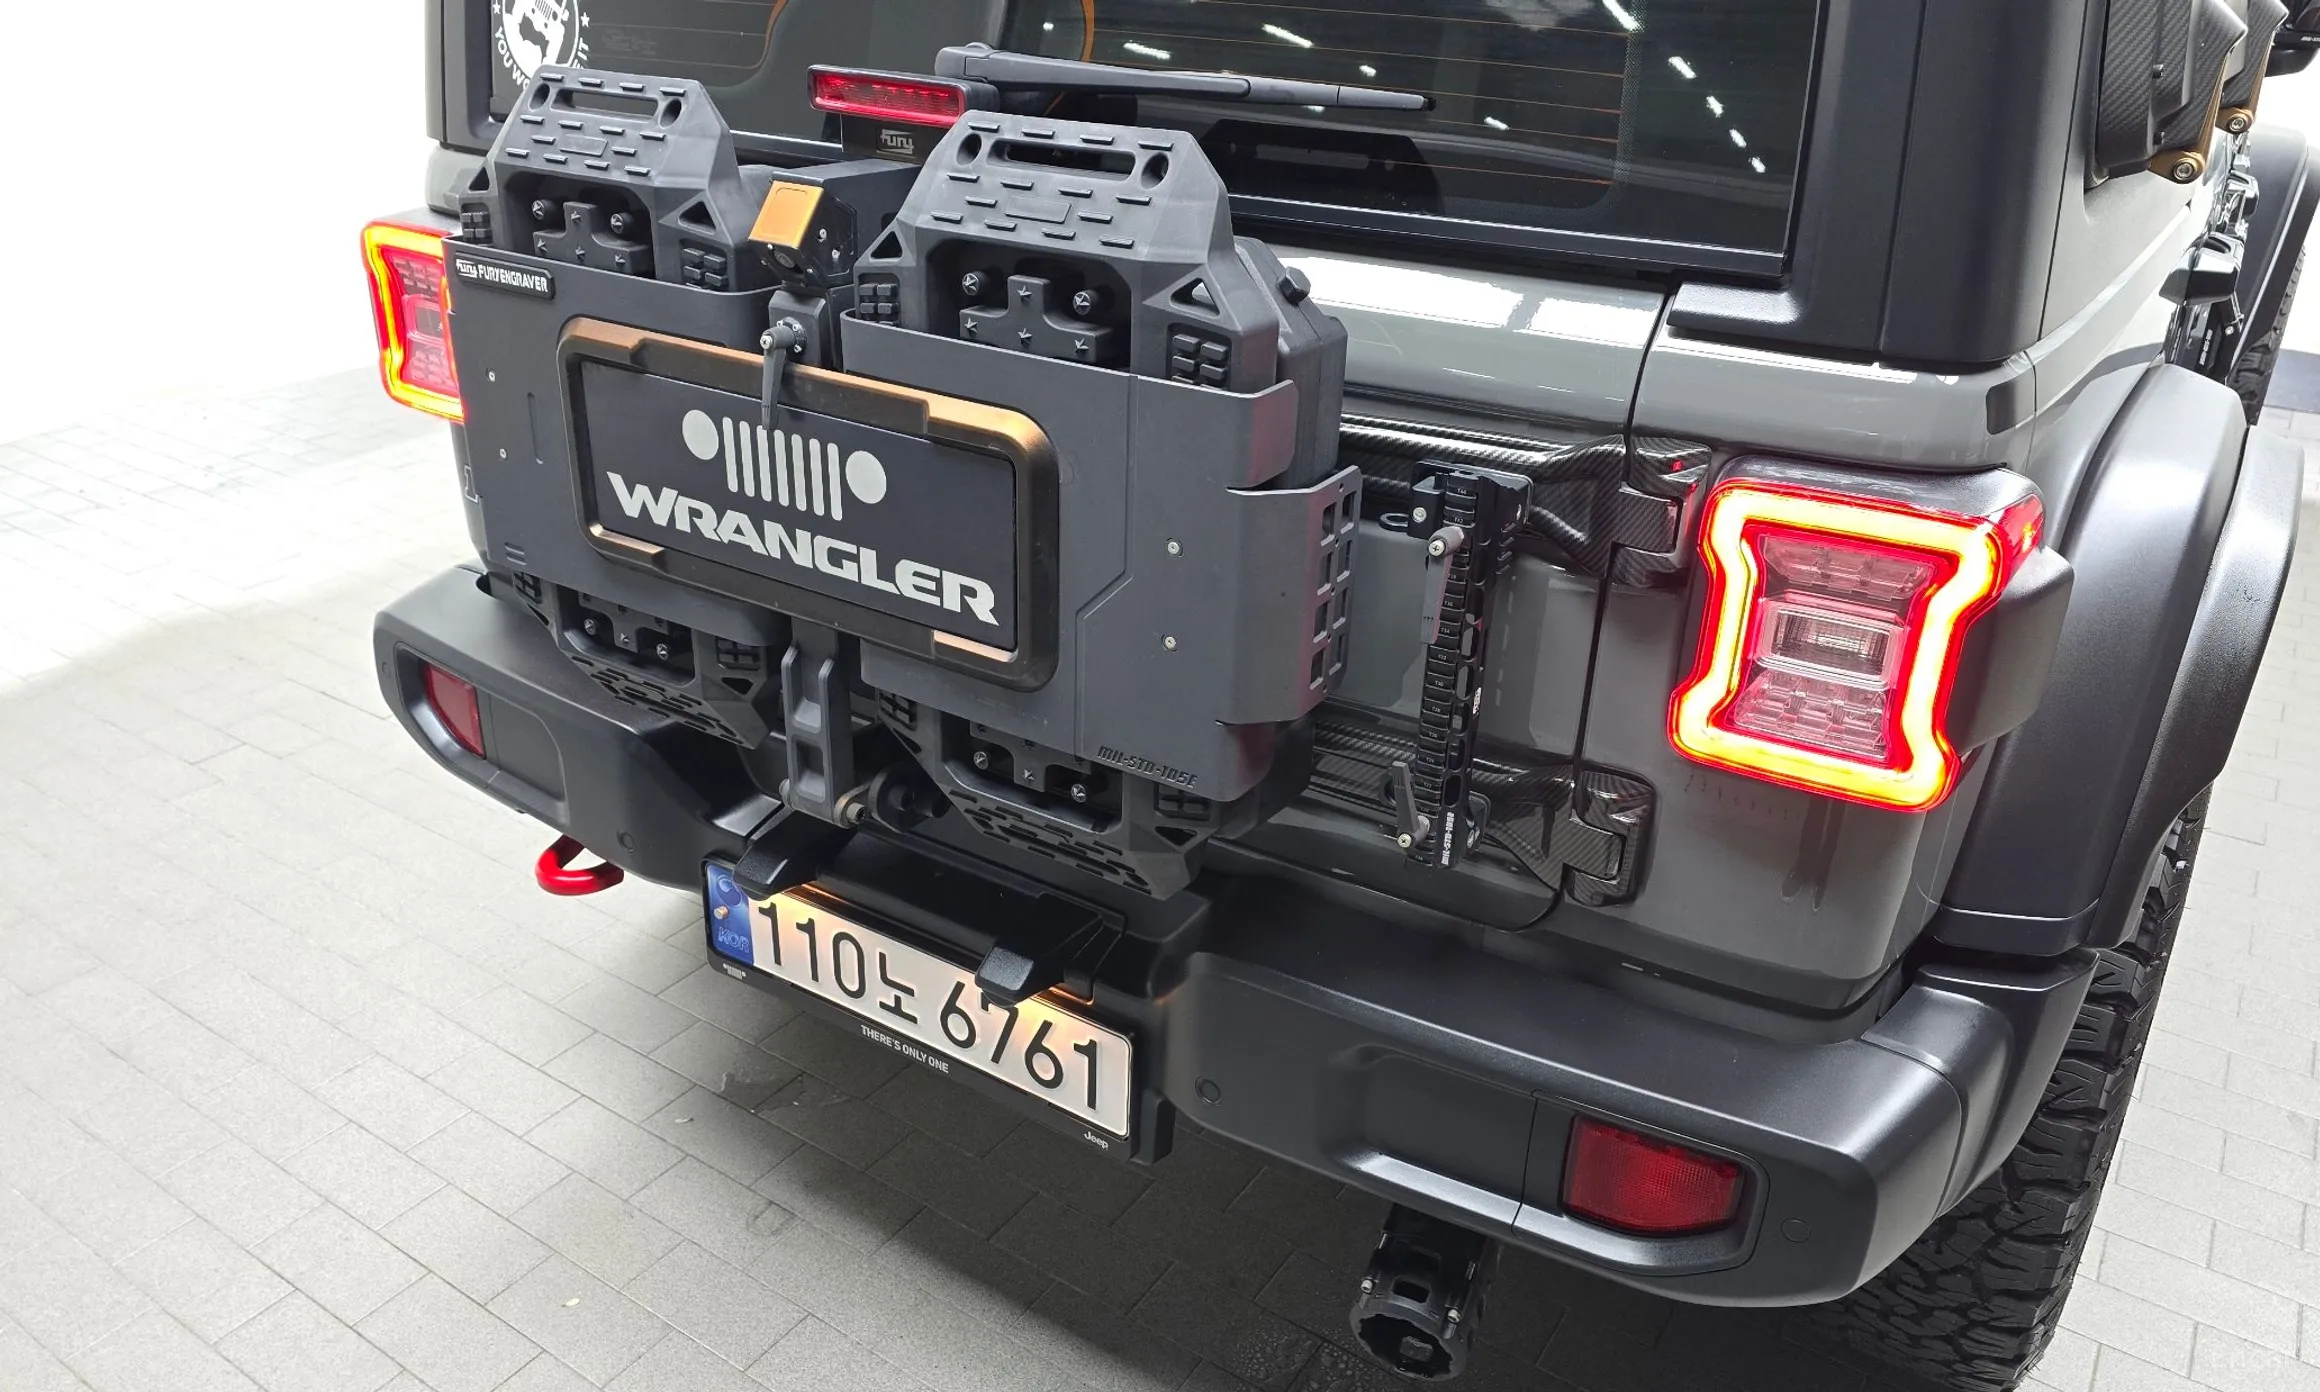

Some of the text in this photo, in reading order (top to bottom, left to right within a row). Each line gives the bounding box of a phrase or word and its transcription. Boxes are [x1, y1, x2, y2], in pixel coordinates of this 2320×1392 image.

[477, 263, 549, 293] FURYENGRAVER
[606, 470, 1000, 627] WRANGLER
[757, 901, 1098, 1111] 110노 6761
[860, 1024, 950, 1074] THERE'S ONLY ONE
[1083, 1131, 1109, 1151] Jeep
